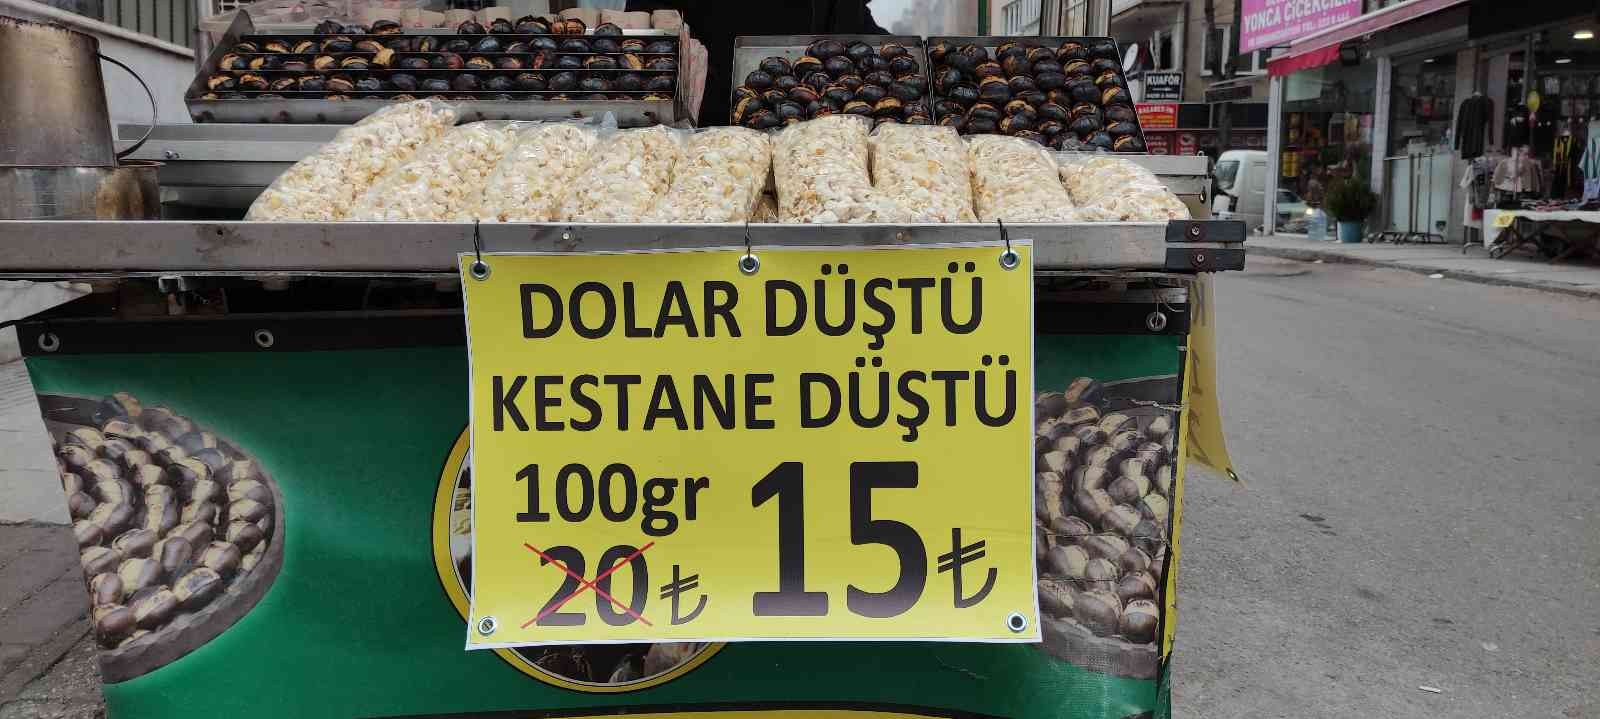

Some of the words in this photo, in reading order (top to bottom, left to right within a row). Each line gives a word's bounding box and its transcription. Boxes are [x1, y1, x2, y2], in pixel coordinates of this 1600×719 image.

[1244, 7, 1281, 33] YONCA
[1147, 74, 1180, 85] KUAFÖR
[520, 280, 741, 339] DOLAR
[764, 262, 983, 350] DÜŞTÜ
[493, 374, 775, 431] KESTANE
[800, 355, 1016, 442] DÜŞTÜ
[516, 463, 709, 537] 100gr
